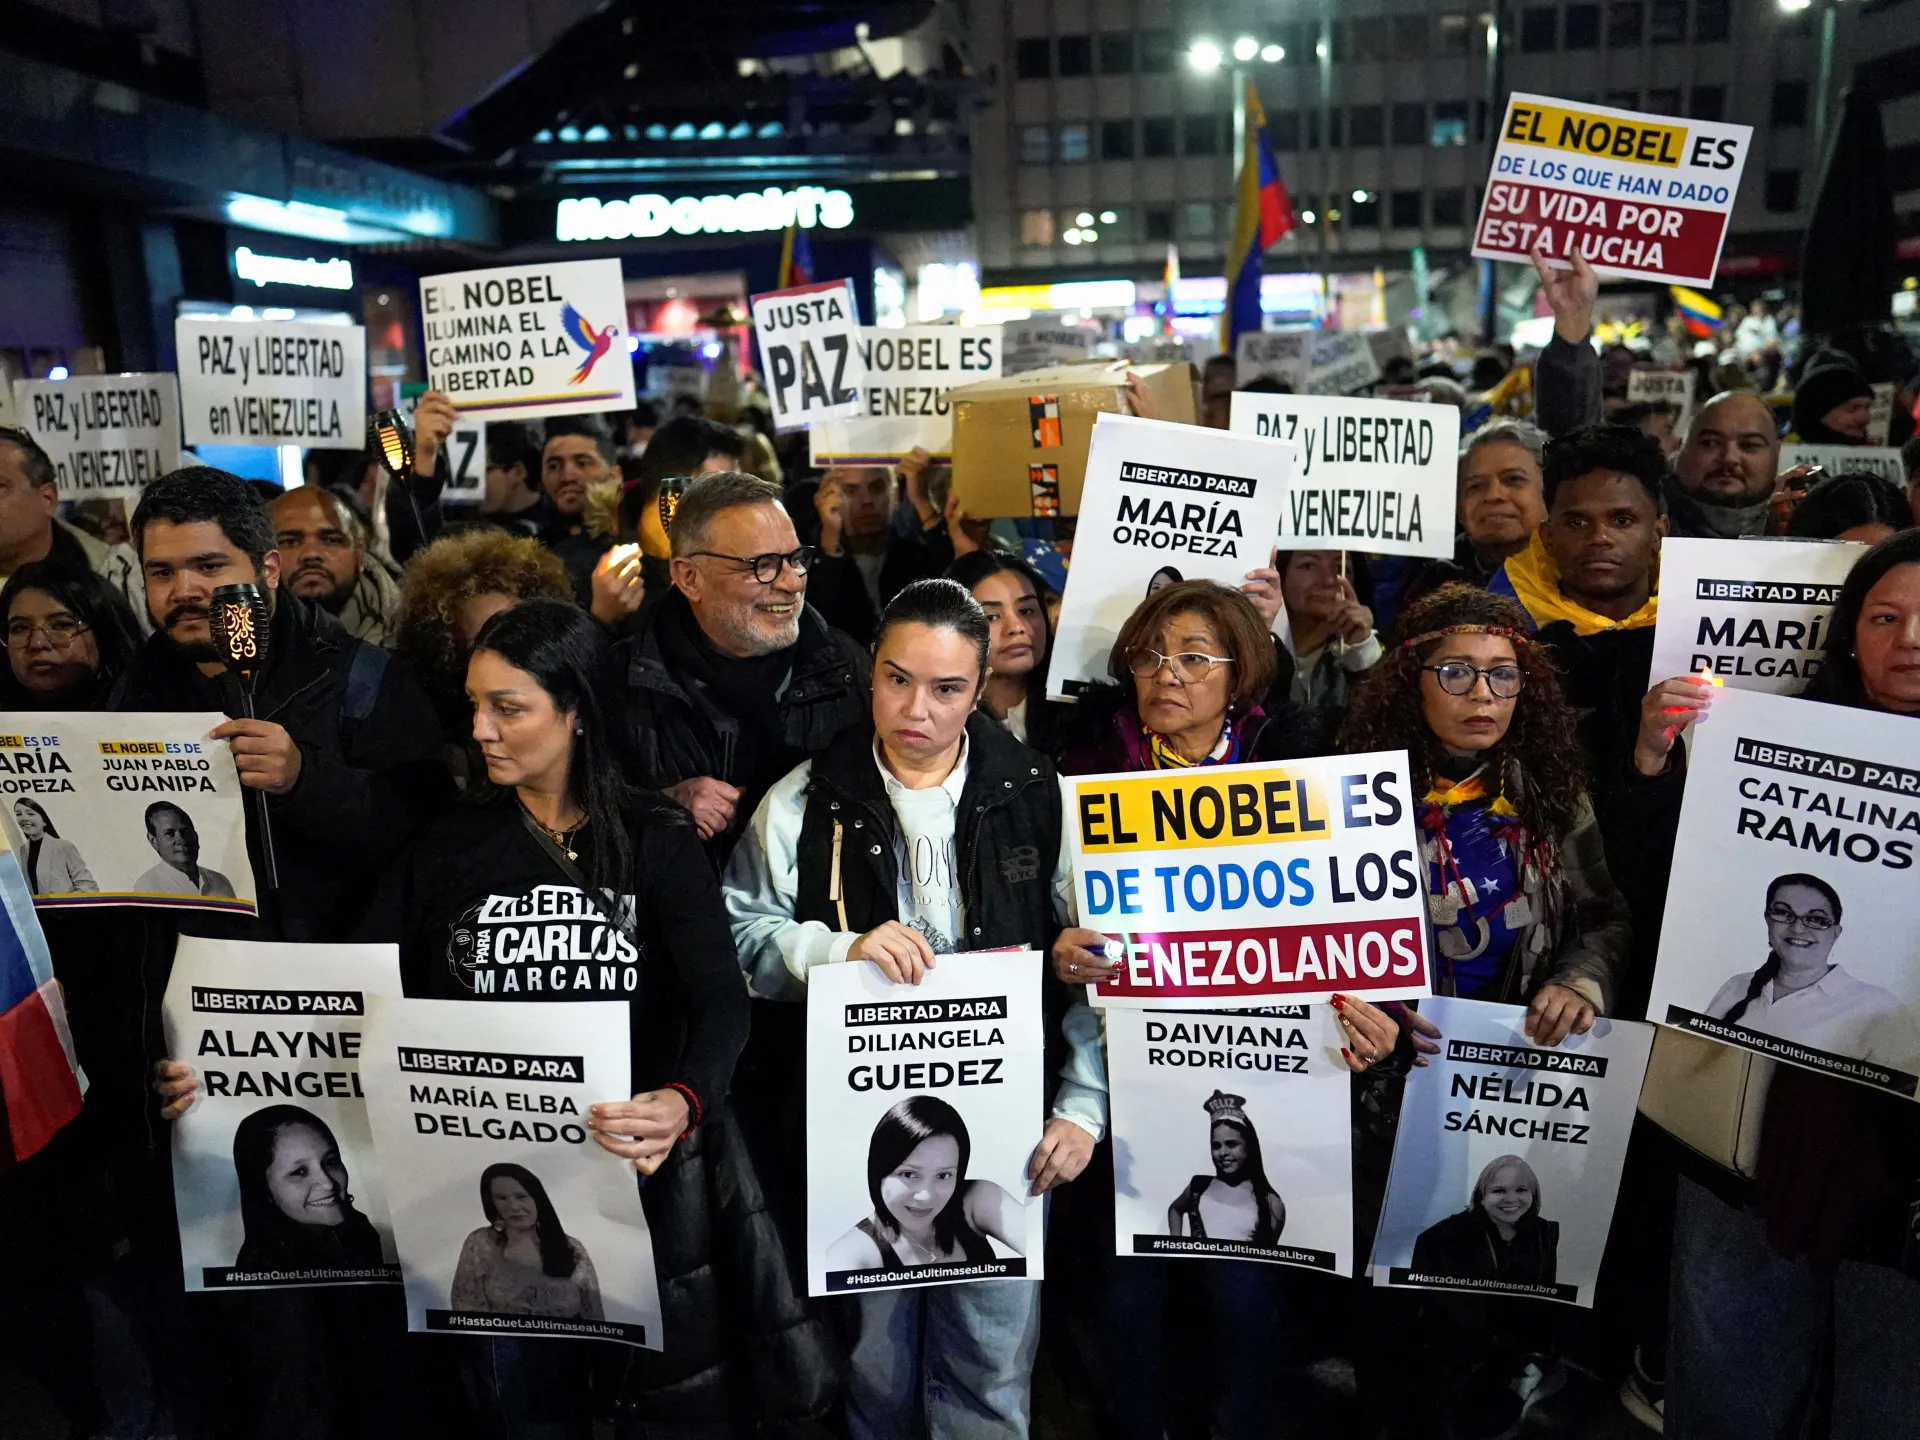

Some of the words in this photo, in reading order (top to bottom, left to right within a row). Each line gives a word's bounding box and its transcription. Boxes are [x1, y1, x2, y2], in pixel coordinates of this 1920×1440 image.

[1506, 108, 1546, 144] EL
[1558, 116, 1678, 164] NOBEL
[1689, 136, 1737, 170] ES
[1497, 155, 1525, 175] DE
[1529, 161, 1567, 182] LOS
[1572, 166, 1612, 189] QUE
[1617, 174, 1661, 196] HAN
[1667, 181, 1729, 205] DADO
[557, 187, 854, 241] McDonald's
[1488, 184, 1531, 215] SU
[1539, 191, 1608, 228] VIDA
[1616, 205, 1684, 238] POR
[1481, 218, 1553, 253] ESTA
[1563, 230, 1664, 270] LUCHA
[463, 275, 562, 309] NOBEL
[426, 315, 512, 342] ILUMINA
[519, 312, 546, 332] EL
[764, 298, 844, 332] JUSTA
[199, 336, 234, 374] PAZ
[240, 350, 250, 385] y
[255, 336, 344, 378] LIBERTAD
[429, 341, 512, 367] CAMINO
[519, 340, 534, 358] A
[542, 337, 570, 357] LA
[960, 338, 992, 370] ES
[431, 367, 534, 394] LIBERTAD
[768, 333, 857, 415] PAZ
[33, 392, 68, 432] PAZ
[69, 402, 79, 441] y
[81, 388, 161, 430] LIBERTAD
[210, 405, 231, 434] en
[235, 398, 341, 438] VENEZUELA
[1303, 428, 1315, 476] y
[1323, 416, 1432, 466] LIBERTAD
[57, 462, 68, 489] n
[1121, 465, 1202, 488] LIBERTAD
[1206, 476, 1250, 495] PARA
[1116, 495, 1244, 538] MARÍA
[1291, 489, 1423, 543] VENEZUELA
[1112, 526, 1238, 559] OROPEZA
[1699, 583, 1797, 600] LIBERTAD
[1803, 588, 1844, 602] PAR
[1696, 615, 1825, 650] MARÍ
[1690, 654, 1825, 679] DELGAD
[0, 736, 21, 747] BEL
[23, 736, 39, 747] ES
[42, 736, 60, 747] DE
[102, 743, 117, 753] EL
[120, 743, 163, 754] NOBEL
[165, 743, 181, 754] ES
[184, 743, 202, 754] DE
[0, 748, 72, 774] ARÍA
[103, 759, 147, 771] JUAN
[152, 759, 210, 771] PABLO
[1737, 743, 1856, 779] LIBERTAD
[1863, 767, 1920, 793] PAR
[0, 778, 76, 793] OPEZA
[106, 775, 217, 792] GUANIPA
[1080, 793, 1137, 845] EL
[1152, 779, 1325, 841] NOBEL
[1341, 772, 1402, 828] ES
[1739, 777, 1920, 836] CATALINA
[1737, 807, 1914, 870] RAMOS
[1085, 869, 1143, 915] DE
[1155, 858, 1314, 912] TODOS
[1329, 850, 1417, 903] LOS
[476, 929, 490, 963] PARA
[495, 925, 638, 964] CARLOS
[1110, 929, 1418, 987] ENEZOLANOS
[475, 966, 637, 993] MARCANO
[194, 992, 291, 1010] LIBERTAD
[299, 996, 357, 1010] PARA
[847, 1005, 942, 1022] LIBERTAD
[949, 1002, 1000, 1018] PARA
[198, 1030, 361, 1058] ALAYNE
[849, 1028, 1004, 1053] DILIANGELA
[1146, 1022, 1309, 1049] DAIVIANA
[1690, 1016, 1890, 1083] #HastaQueLaUltimaseaLibre
[401, 1052, 507, 1073] LIBERTAD
[514, 1060, 576, 1078] PARA
[1149, 1048, 1308, 1074] RODRÍGUEZ
[1449, 1044, 1541, 1065] LIBERTAD
[1547, 1056, 1599, 1073] PARA
[848, 1058, 1003, 1092] GUEDEZ
[410, 1085, 498, 1108] MARÍA
[506, 1093, 579, 1115] ELBA
[1451, 1072, 1590, 1111] NÉLIDA
[415, 1113, 586, 1144] DELGADO
[1444, 1110, 1590, 1144] SÁNCHEZ
[1153, 1240, 1315, 1262] #HastaQueLaUltimaseaLibre
[226, 1268, 402, 1281] #HastaQueLaUltimaseaLibre
[847, 1264, 1007, 1284] #HastaQueLaUltimaseaLibre
[1408, 1273, 1557, 1295] #HastaQueLaUltimaseaLibre
[449, 1316, 624, 1336] #HastaQueLaUltimaseaLibre
